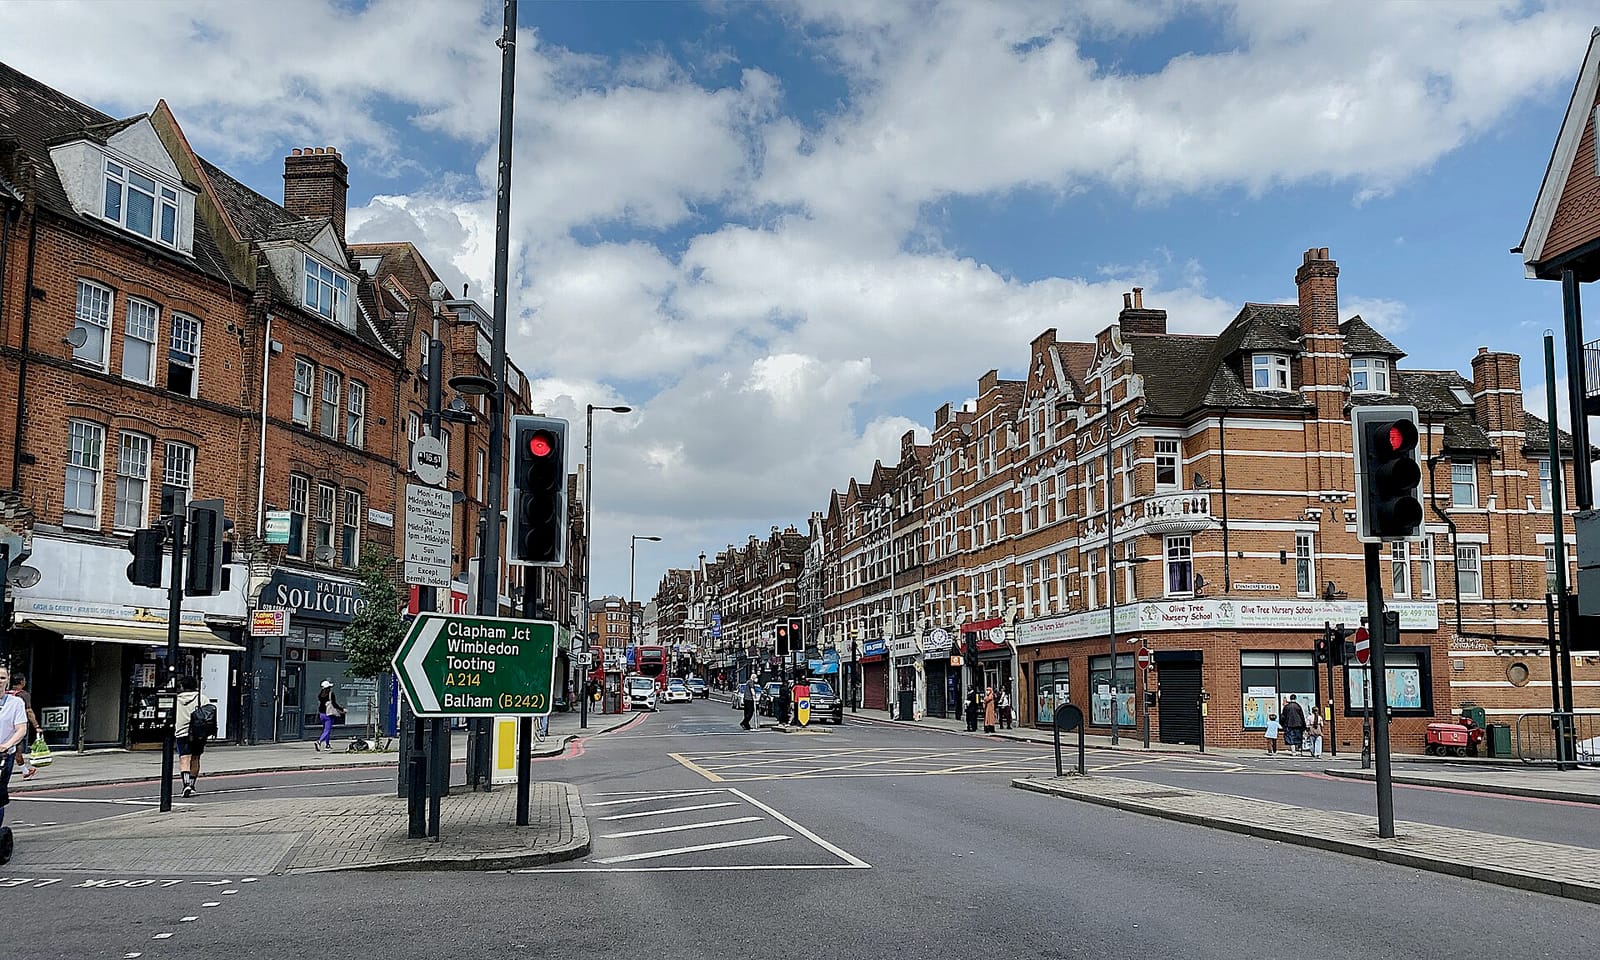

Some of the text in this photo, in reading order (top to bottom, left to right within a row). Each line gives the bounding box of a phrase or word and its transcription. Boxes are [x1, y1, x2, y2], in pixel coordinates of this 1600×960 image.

[417, 489, 430, 498] Mon
[435, 492, 443, 500] Fri
[408, 496, 434, 507] Midnight
[438, 501, 451, 510] 7am
[407, 504, 421, 513] 9pm
[426, 507, 451, 519] Midnight
[407, 522, 433, 534] Midnight
[438, 527, 450, 536] 7am
[424, 518, 435, 527] Sat
[408, 531, 420, 540] 1pm
[425, 534, 450, 545] Midnight
[423, 546, 435, 554] Sun
[411, 553, 446, 564] At any time
[417, 566, 438, 577] Except
[406, 575, 449, 587] permit holders
[317, 581, 353, 596] HATTIN
[1168, 604, 1204, 613] Olive Tree
[1241, 605, 1255, 614] Olive
[1256, 605, 1270, 614] Tree
[1271, 605, 1294, 616] Nursery
[1295, 605, 1314, 614] School
[1161, 612, 1213, 623] Nursery School
[447, 622, 531, 641] Clapham Jct
[447, 638, 519, 656] Wimbledon
[446, 655, 496, 673] Tooting
[444, 693, 493, 708] Balham
